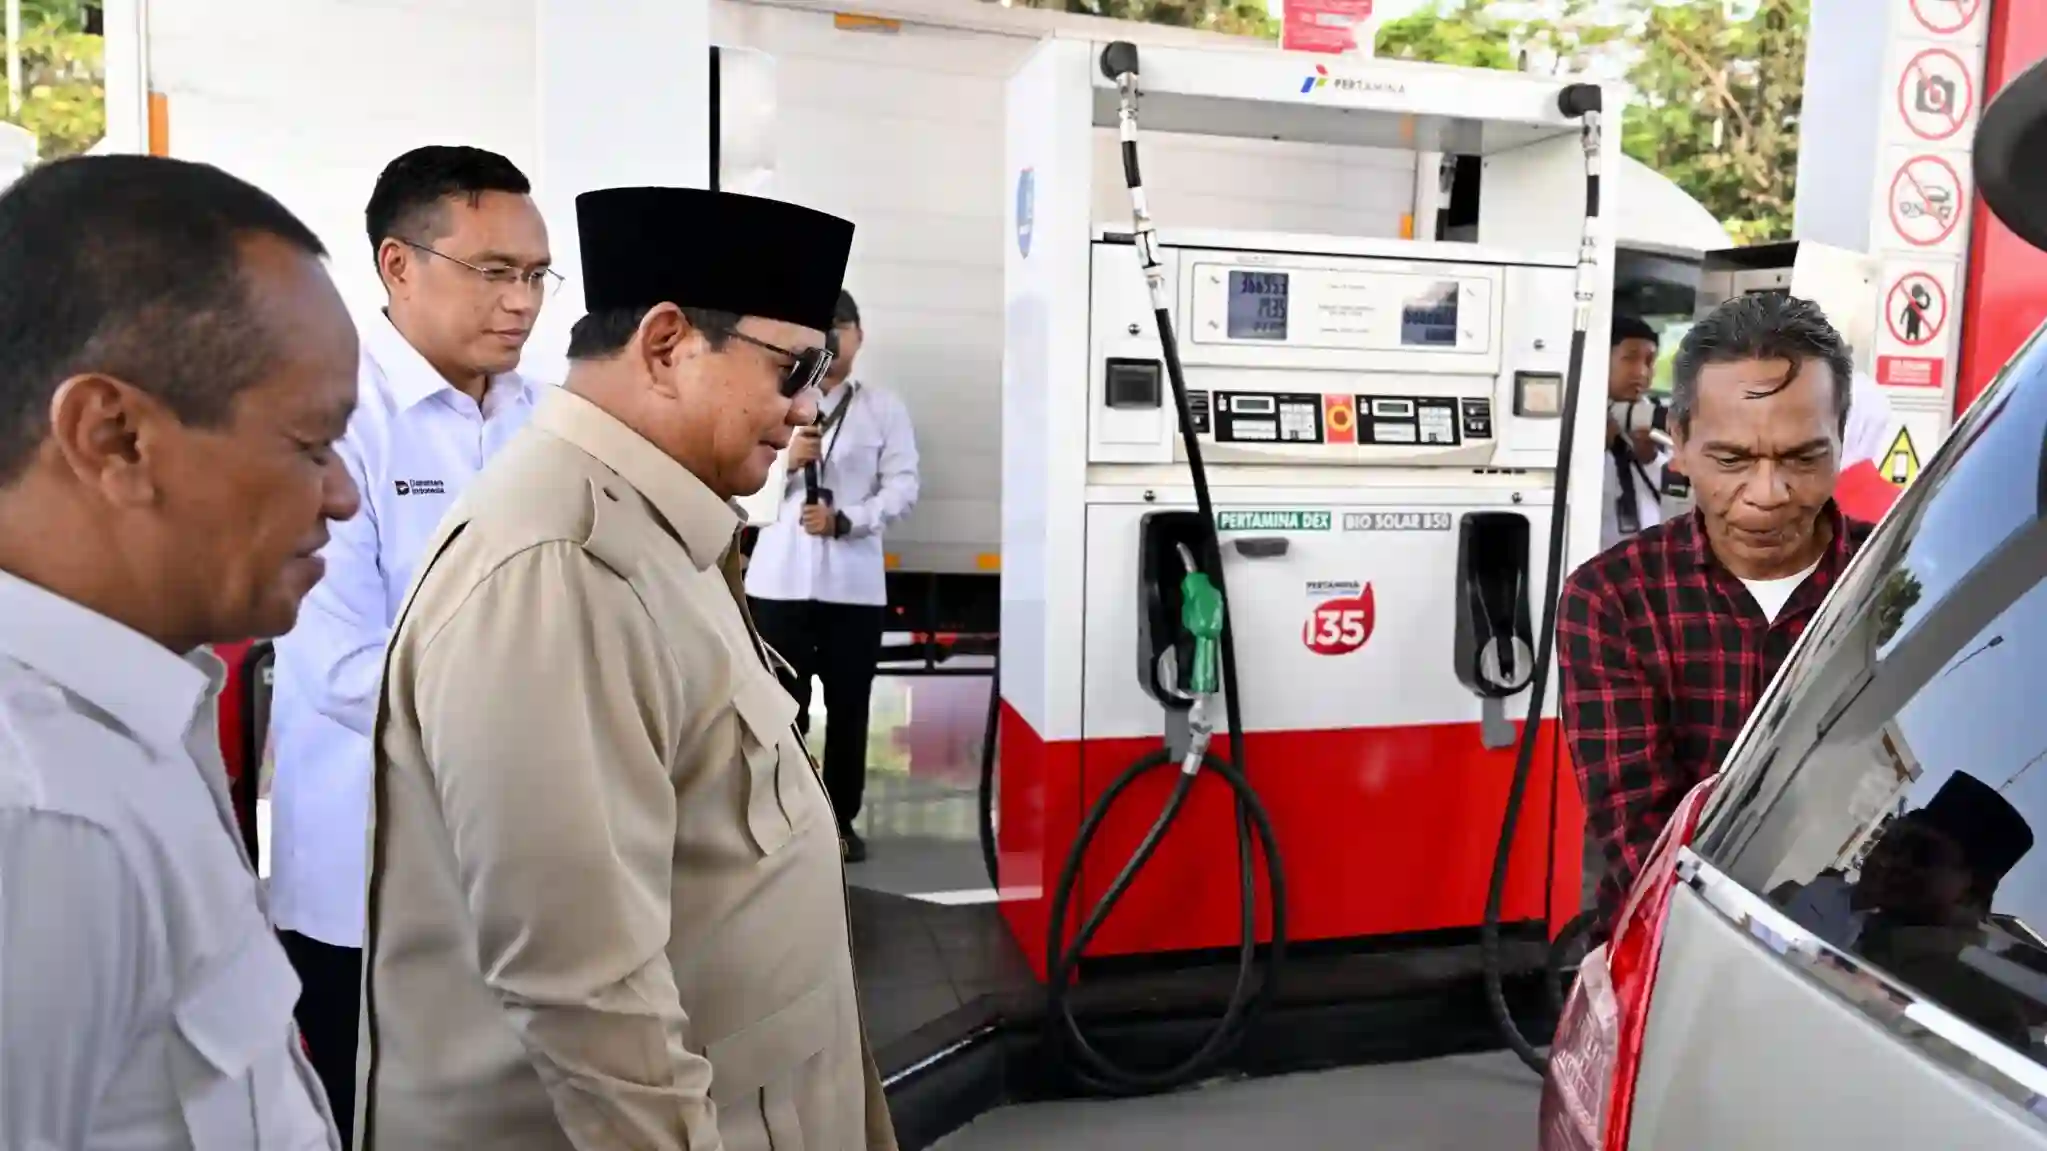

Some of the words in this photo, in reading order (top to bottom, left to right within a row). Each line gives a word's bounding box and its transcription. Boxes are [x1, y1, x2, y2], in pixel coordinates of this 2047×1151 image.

[1334, 78, 1405, 93] PERTAMINA
[1221, 512, 1299, 529] PERTAMINA
[1302, 512, 1329, 529] DEX
[1345, 514, 1372, 530] BIO
[1374, 514, 1420, 530] SOLAR
[1305, 580, 1360, 589] PERTAMINA
[1306, 609, 1365, 645] 135
